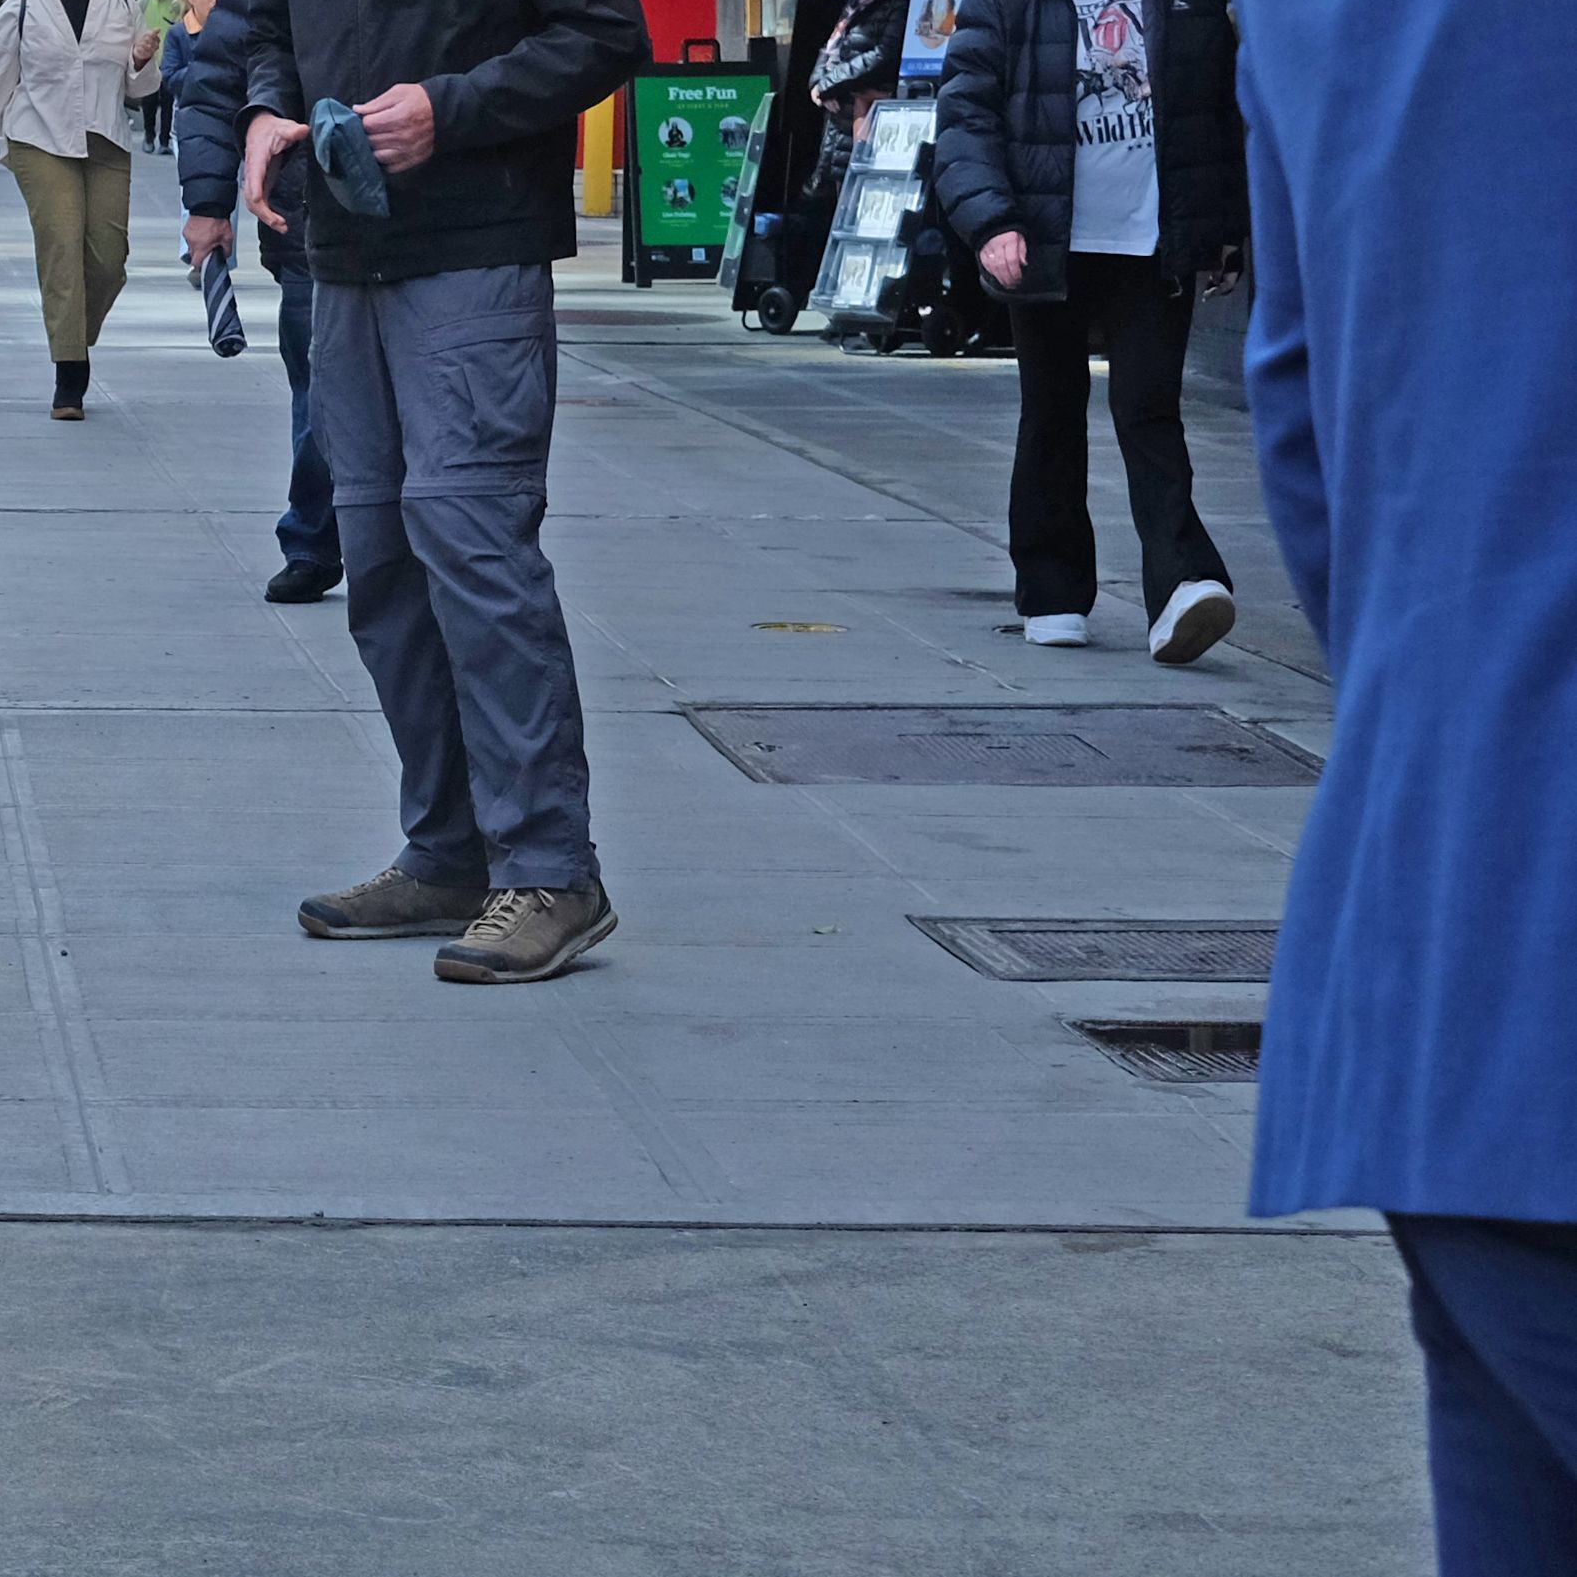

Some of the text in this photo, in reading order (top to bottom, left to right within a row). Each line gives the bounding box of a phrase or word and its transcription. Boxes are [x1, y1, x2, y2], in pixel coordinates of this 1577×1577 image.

[668, 86, 738, 101] Free Fun
[1076, 114, 1126, 146] Wild
